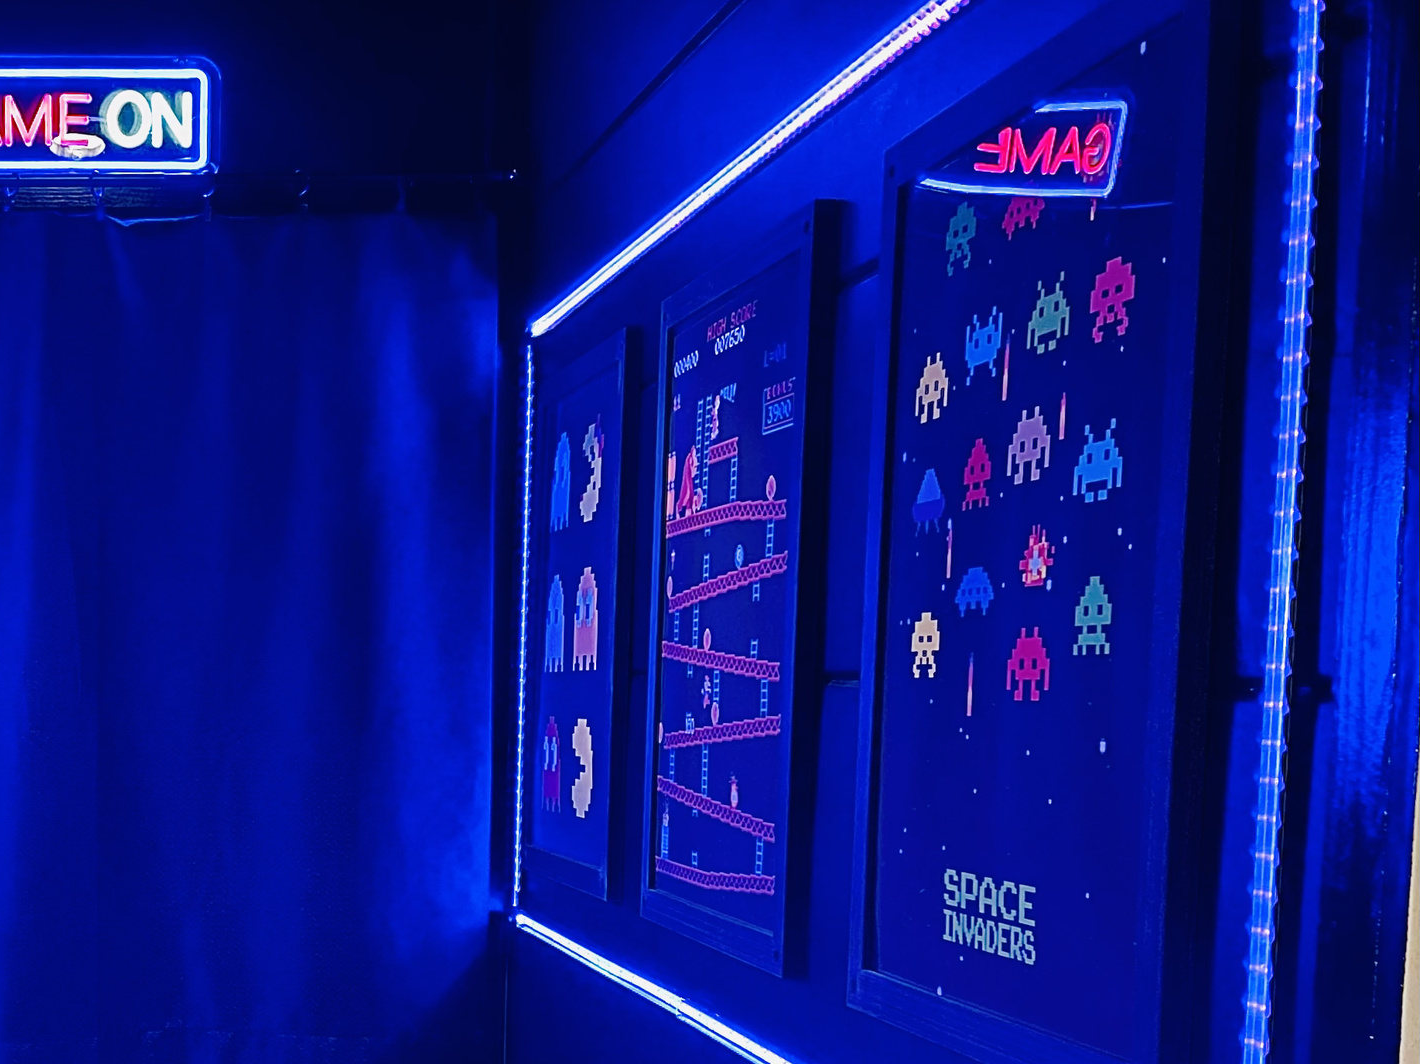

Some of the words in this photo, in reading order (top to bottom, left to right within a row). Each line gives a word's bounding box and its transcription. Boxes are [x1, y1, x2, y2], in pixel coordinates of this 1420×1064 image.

[102, 89, 193, 149] ON
[707, 316, 727, 343] HIGH
[730, 299, 758, 329] SCORE
[714, 324, 746, 356] 007650
[943, 868, 1036, 927] SPACE
[942, 908, 1037, 966] INVADERS
